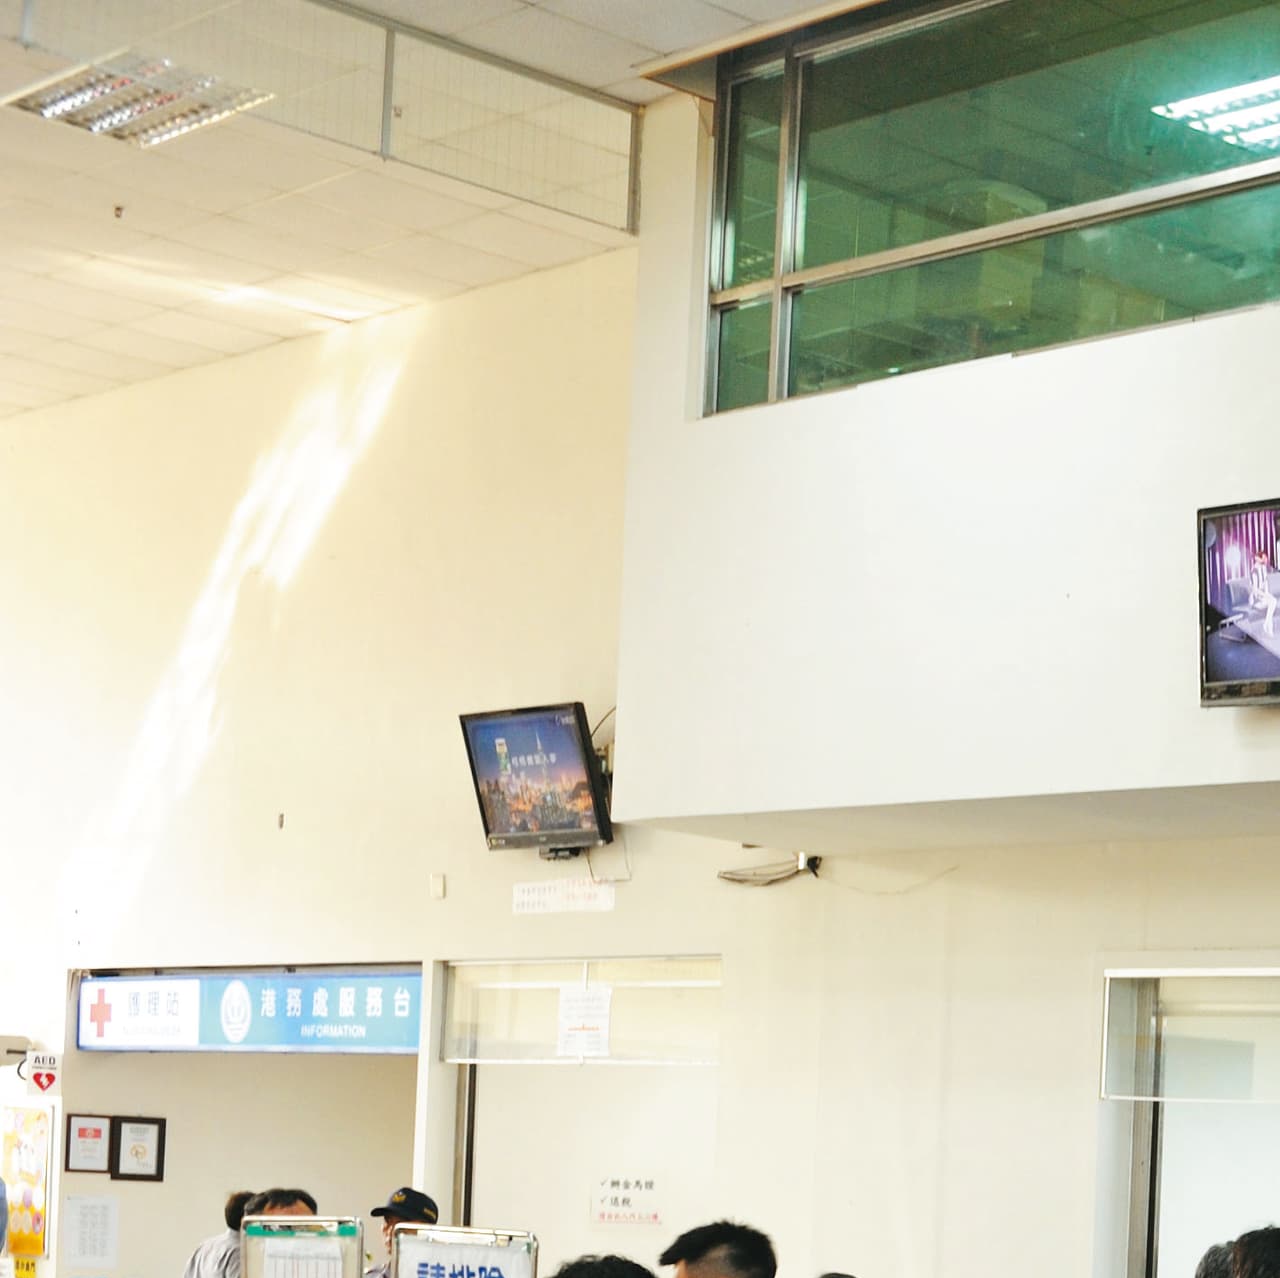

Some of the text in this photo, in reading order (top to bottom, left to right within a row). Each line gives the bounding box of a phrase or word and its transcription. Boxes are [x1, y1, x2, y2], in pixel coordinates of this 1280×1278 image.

[260, 986, 411, 1018] 港務處服務台
[300, 1024, 366, 1039] INFORMATION
